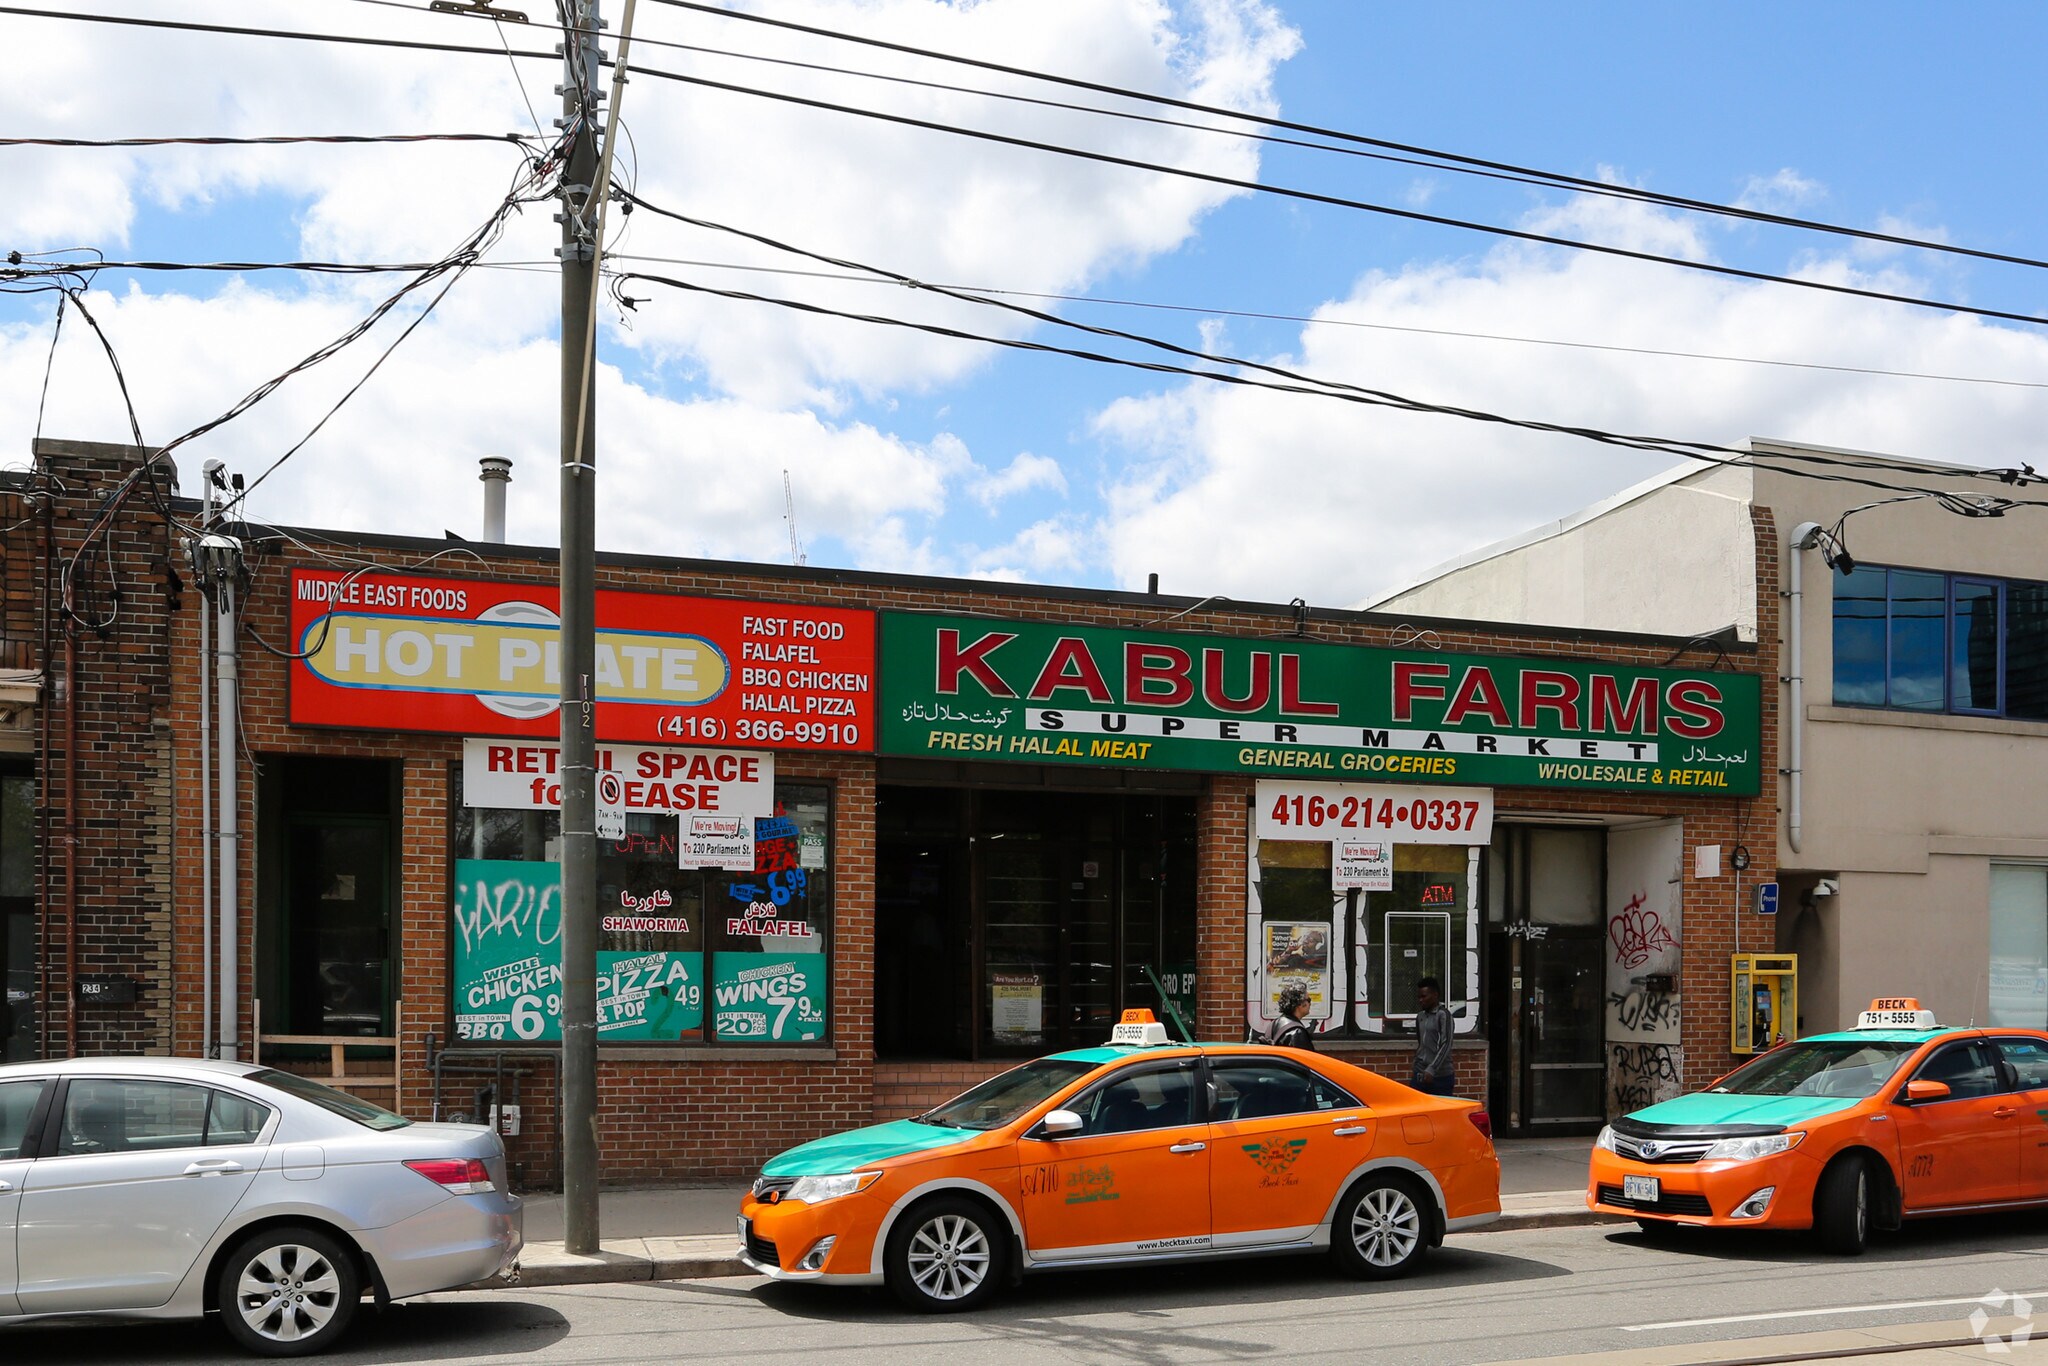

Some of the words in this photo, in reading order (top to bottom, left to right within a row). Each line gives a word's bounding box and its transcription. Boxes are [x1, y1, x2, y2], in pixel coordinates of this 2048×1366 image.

[297, 579, 360, 604] MIDDLE
[364, 583, 408, 607] EAST
[411, 587, 467, 611] FOODS
[742, 616, 788, 637] FAST
[792, 620, 844, 641] FOOD
[335, 626, 474, 678] HOT
[742, 642, 820, 664] FALAFEL
[742, 667, 781, 688] BBQ
[786, 669, 869, 692] CHICKEN
[935, 628, 1340, 718] KABUL
[1391, 661, 1726, 740] FARMS
[741, 693, 801, 714] HALAL
[805, 696, 857, 717] PIZZA
[656, 715, 727, 741] (416)
[735, 719, 859, 745] 366-9910
[927, 730, 1003, 752] FRESH
[1009, 736, 1084, 757] HALAL
[1090, 740, 1152, 760] MEAT
[637, 751, 760, 783] SPACE
[1238, 748, 1335, 770] GENERAL
[1340, 753, 1457, 775] GROCERIES
[1538, 763, 1647, 784] WHOLESALE
[1651, 770, 1664, 785] &
[1669, 770, 1729, 788] RETAIL
[624, 781, 720, 811] EASE
[694, 821, 712, 831] We're
[713, 821, 737, 833] Moving!
[614, 832, 675, 854] OPEN
[683, 843, 692, 853] To
[692, 843, 705, 854] 230
[706, 843, 741, 855] Parliament
[742, 844, 751, 855] St.
[803, 838, 822, 846] PASS
[1336, 867, 1342, 876] To
[1343, 867, 1353, 876] 230
[1354, 866, 1381, 876] Parliament
[1421, 885, 1454, 904] ATM
[602, 916, 689, 933] SHAWORMA
[727, 918, 813, 937] FALAFEL
[484, 957, 539, 981] WHOLE
[614, 953, 666, 973] HALAL
[739, 962, 794, 982] CHICKEN
[82, 984, 100, 993] 234
[596, 960, 689, 1000] PIZZA
[715, 972, 807, 1007] WINGS
[674, 984, 700, 1006] 49
[1878, 999, 1907, 1010] BECK
[511, 994, 545, 1040] 6
[613, 1000, 646, 1020] POP
[766, 996, 796, 1040] 7
[1125, 1011, 1140, 1021] BECK
[457, 1022, 505, 1040] BBQ
[718, 1019, 753, 1034] 20
[752, 1018, 766, 1026] PCS
[752, 1025, 766, 1033] FOR
[1116, 1026, 1143, 1039] 751-5555
[1136, 1237, 1211, 1250] www.becktaxi.com
